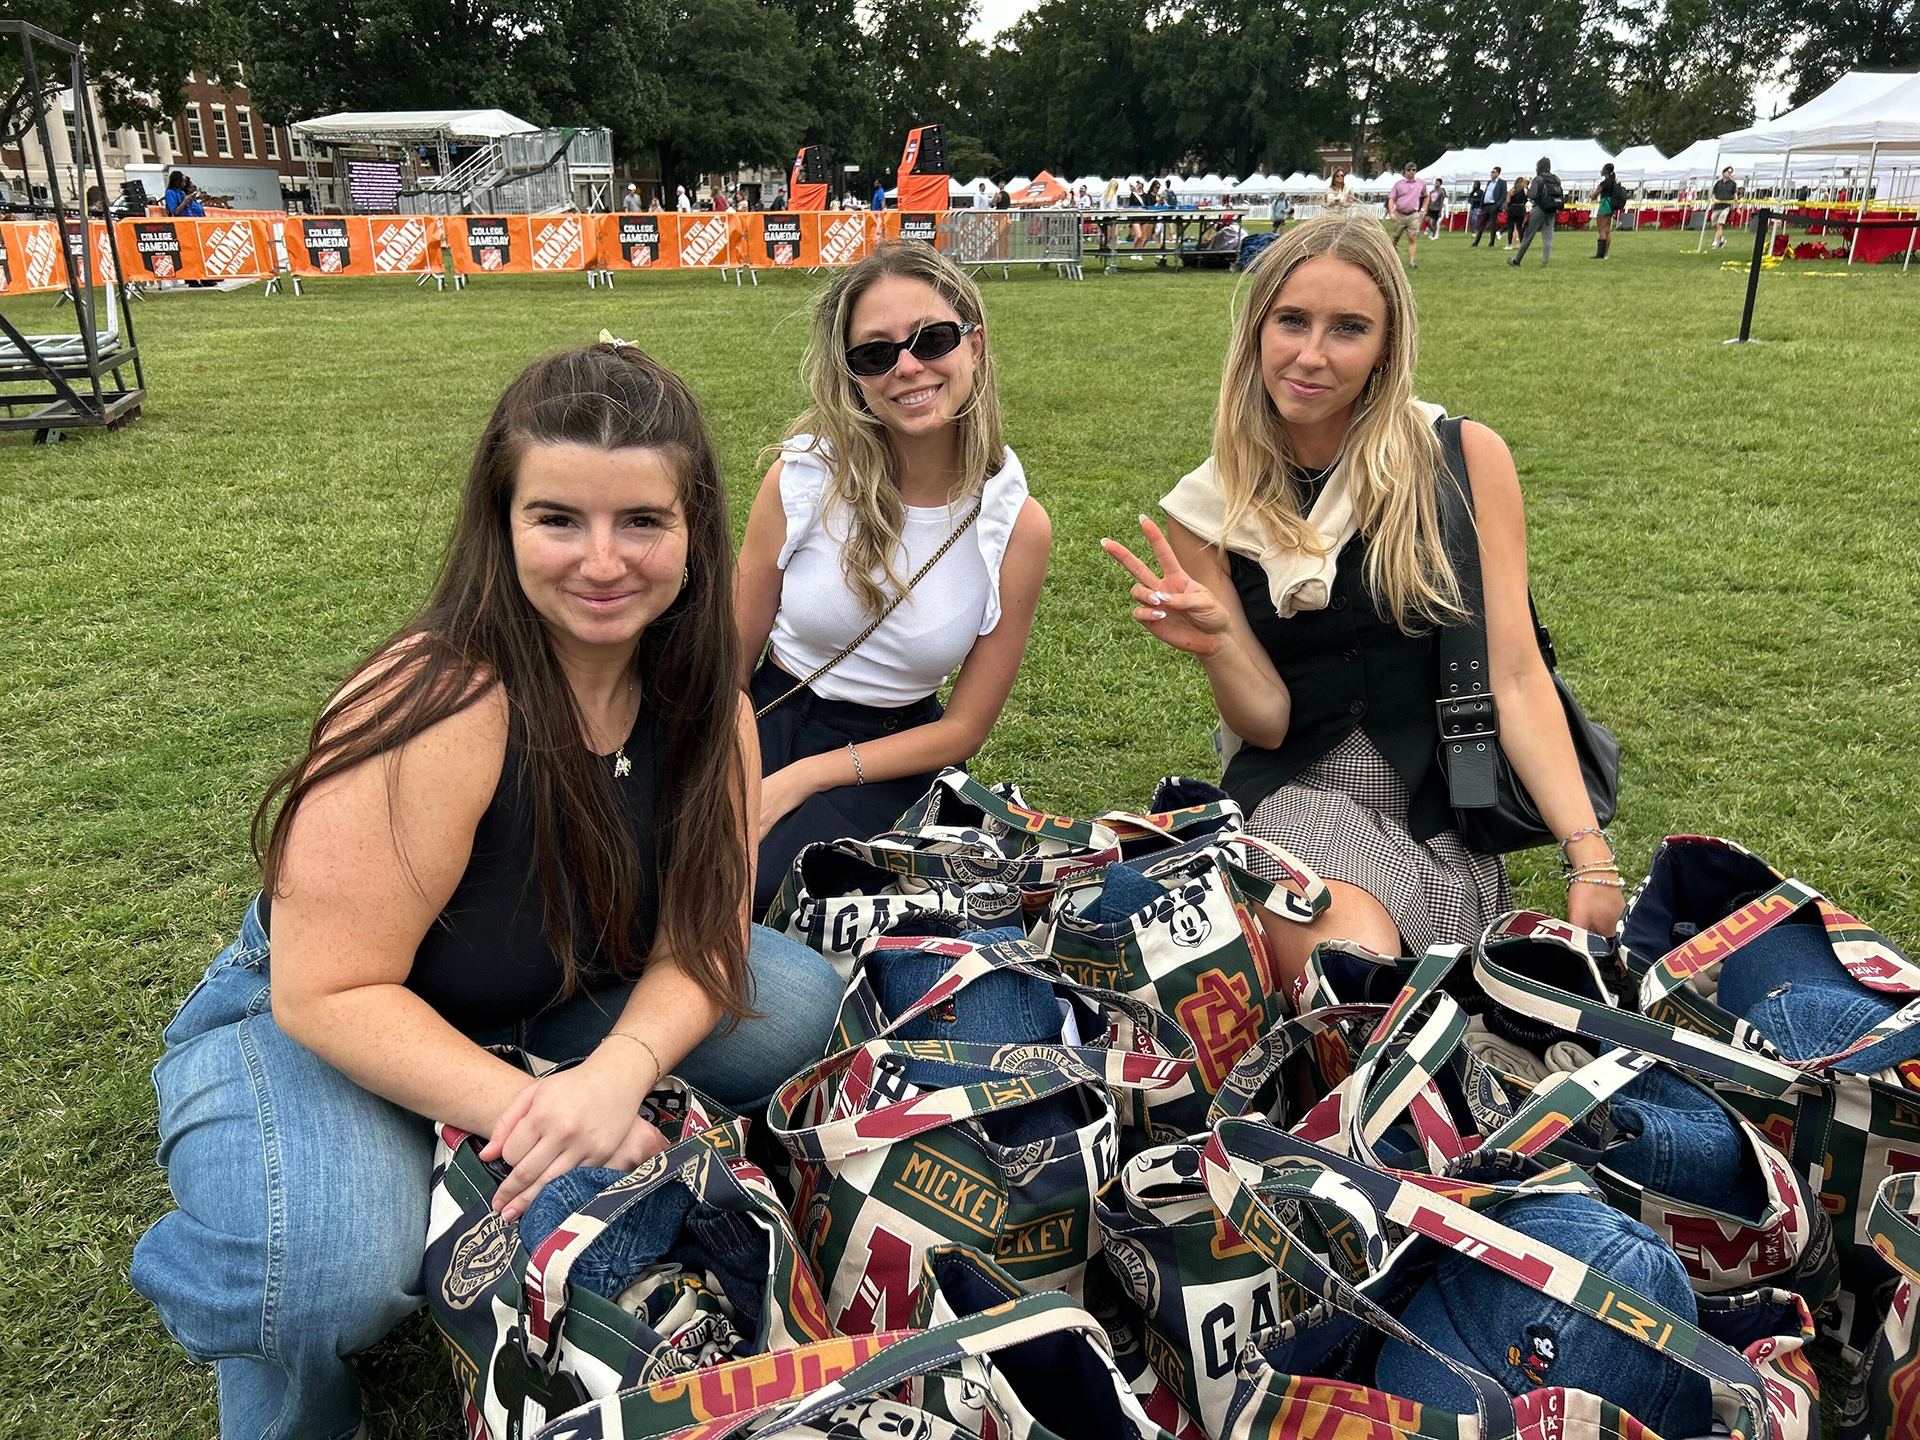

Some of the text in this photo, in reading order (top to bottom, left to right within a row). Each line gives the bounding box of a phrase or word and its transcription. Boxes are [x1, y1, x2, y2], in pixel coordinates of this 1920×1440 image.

[141, 233, 173, 241] COLLEGE
[308, 229, 343, 237] COLLEGE
[377, 224, 399, 246] THE
[472, 227, 504, 235] COLLEGE
[535, 222, 557, 243] THE
[623, 224, 655, 232] COLLEGE
[684, 220, 705, 241] THE
[764, 231, 800, 242] GAMEDAY
[824, 219, 843, 239] THE
[904, 222, 932, 230] COLLEGE
[138, 242, 179, 252] GAMEDAY
[205, 227, 226, 249] THE
[205, 221, 252, 275] HOME
[305, 238, 348, 247] GAMEDAY
[375, 217, 425, 272] HOME
[468, 236, 509, 246] GAMEDAY
[533, 216, 581, 270] HOME
[619, 233, 659, 243] GAMEDAY
[680, 214, 727, 266] HOME
[820, 213, 864, 263] HOME
[226, 241, 255, 275] DEPOT
[396, 235, 427, 271] DEPOT
[553, 235, 583, 269] DEPOT
[700, 234, 729, 266] DEPOT
[968, 893, 998, 910] ABLISHED
[1063, 963, 1118, 991] CKEY
[901, 1152, 1008, 1230] MICKEY
[998, 1217, 1074, 1256] CKEY
[1102, 1230, 1148, 1289] PARTMENT
[1149, 1334, 1187, 1400] CKEY
